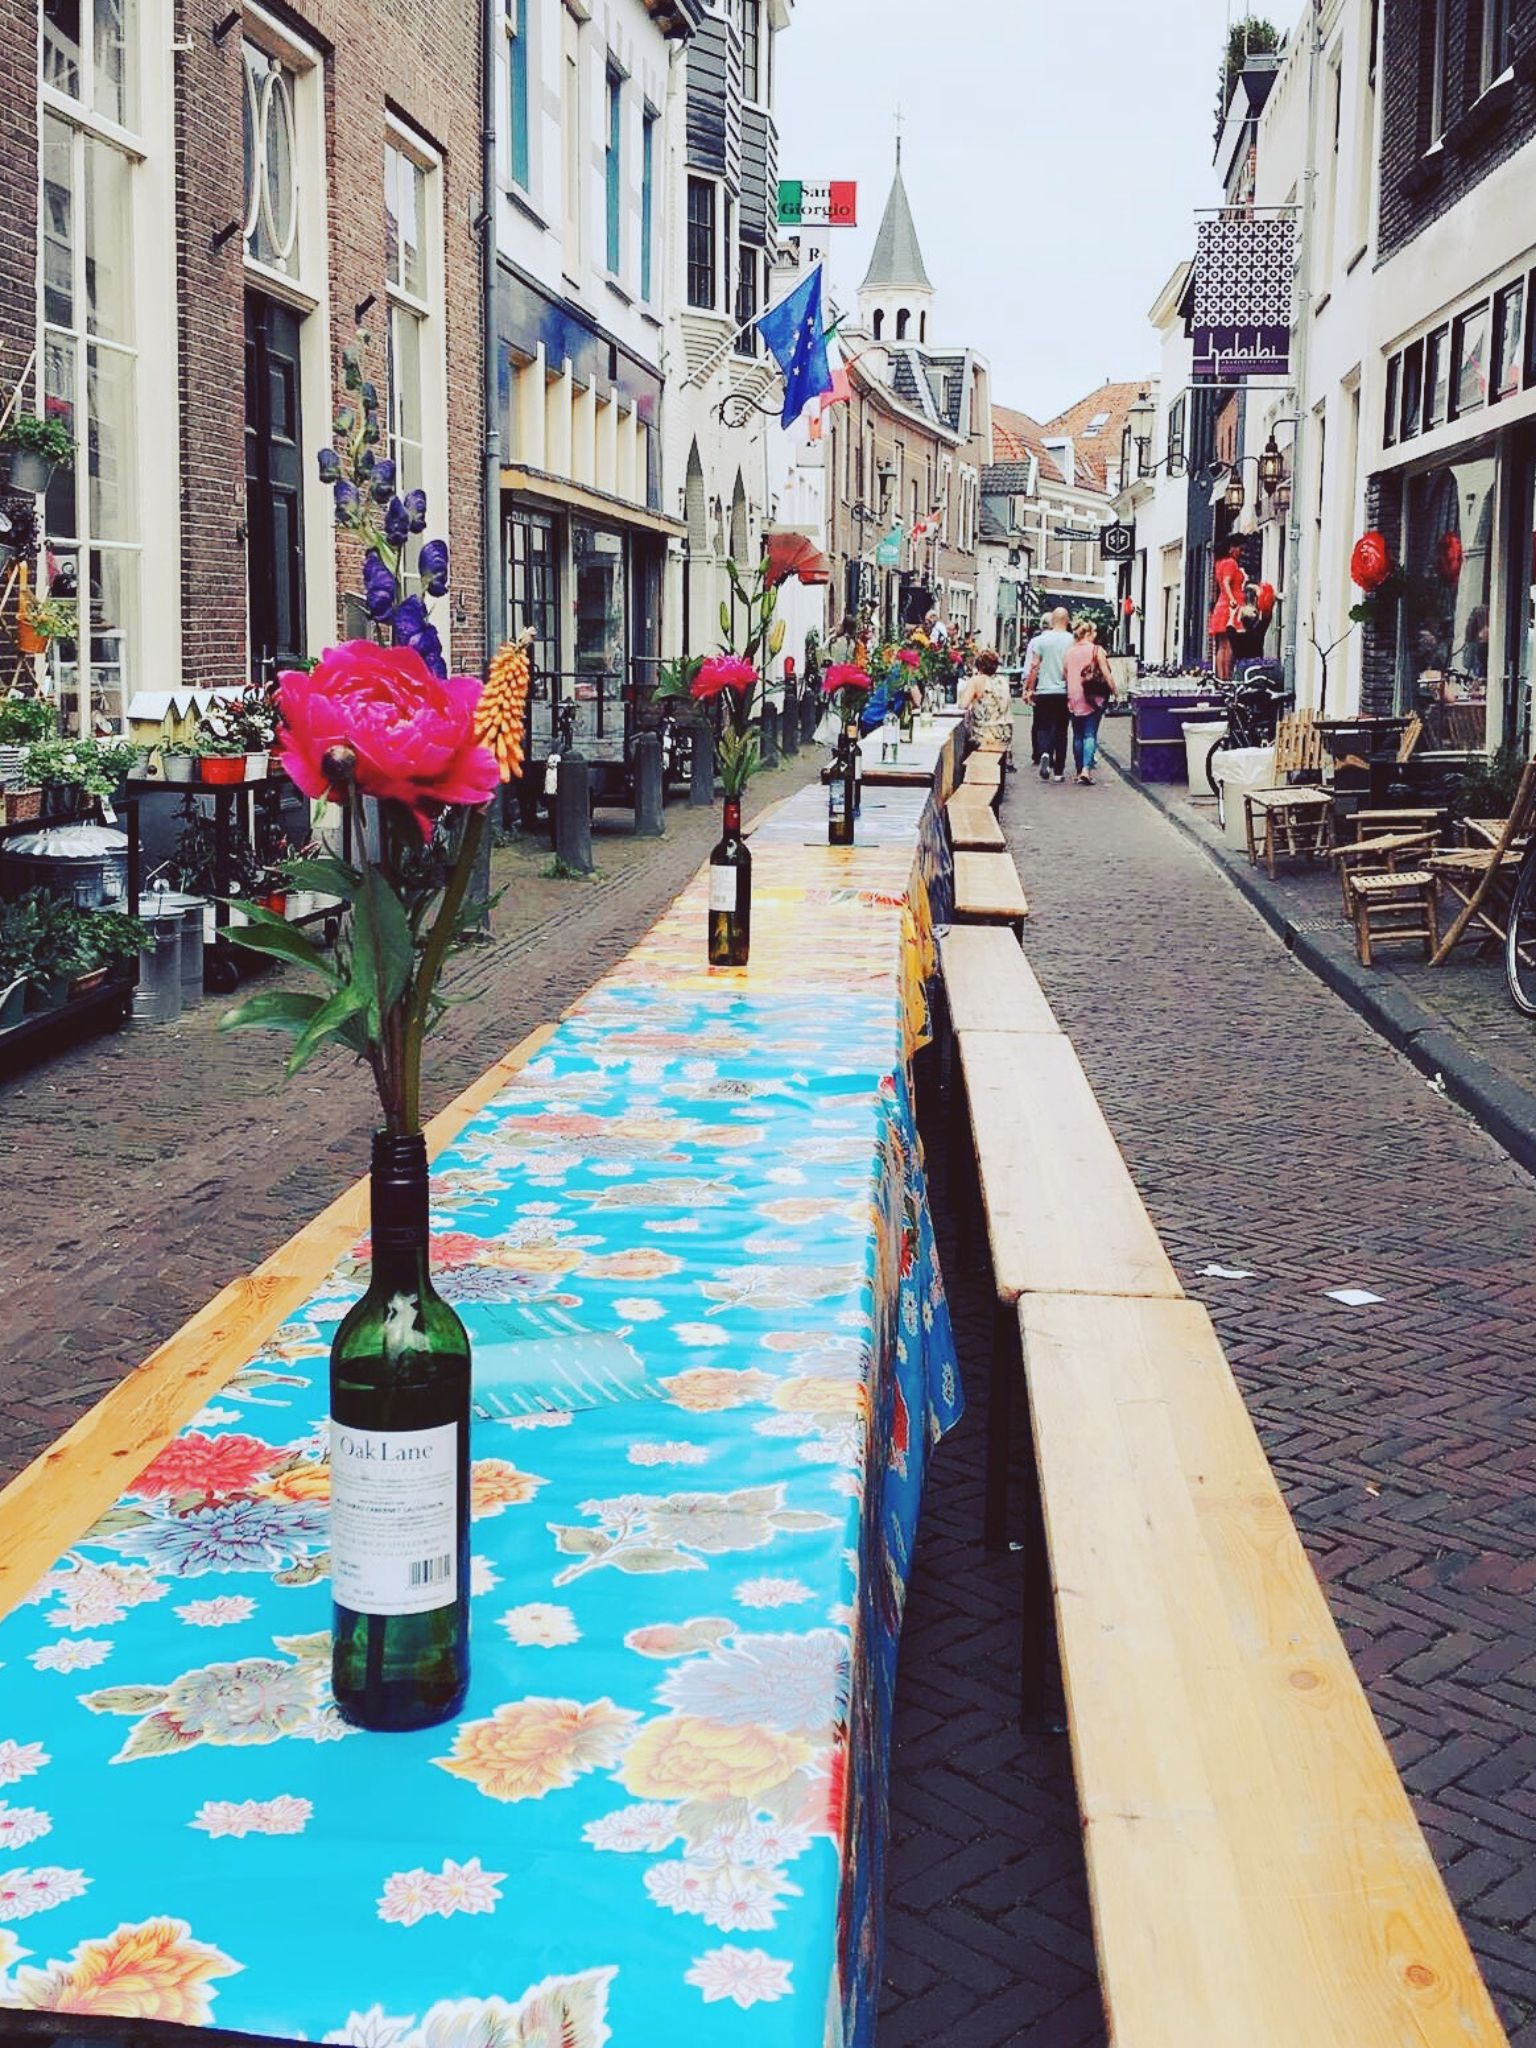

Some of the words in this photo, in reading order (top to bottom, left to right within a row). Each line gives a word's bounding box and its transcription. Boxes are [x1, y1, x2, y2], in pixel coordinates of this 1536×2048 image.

[801, 186, 832, 198] San
[781, 202, 850, 219] Giorgio
[1208, 332, 1276, 375] habibi
[339, 1436, 377, 1460] Oak
[381, 1442, 434, 1461] Lane
